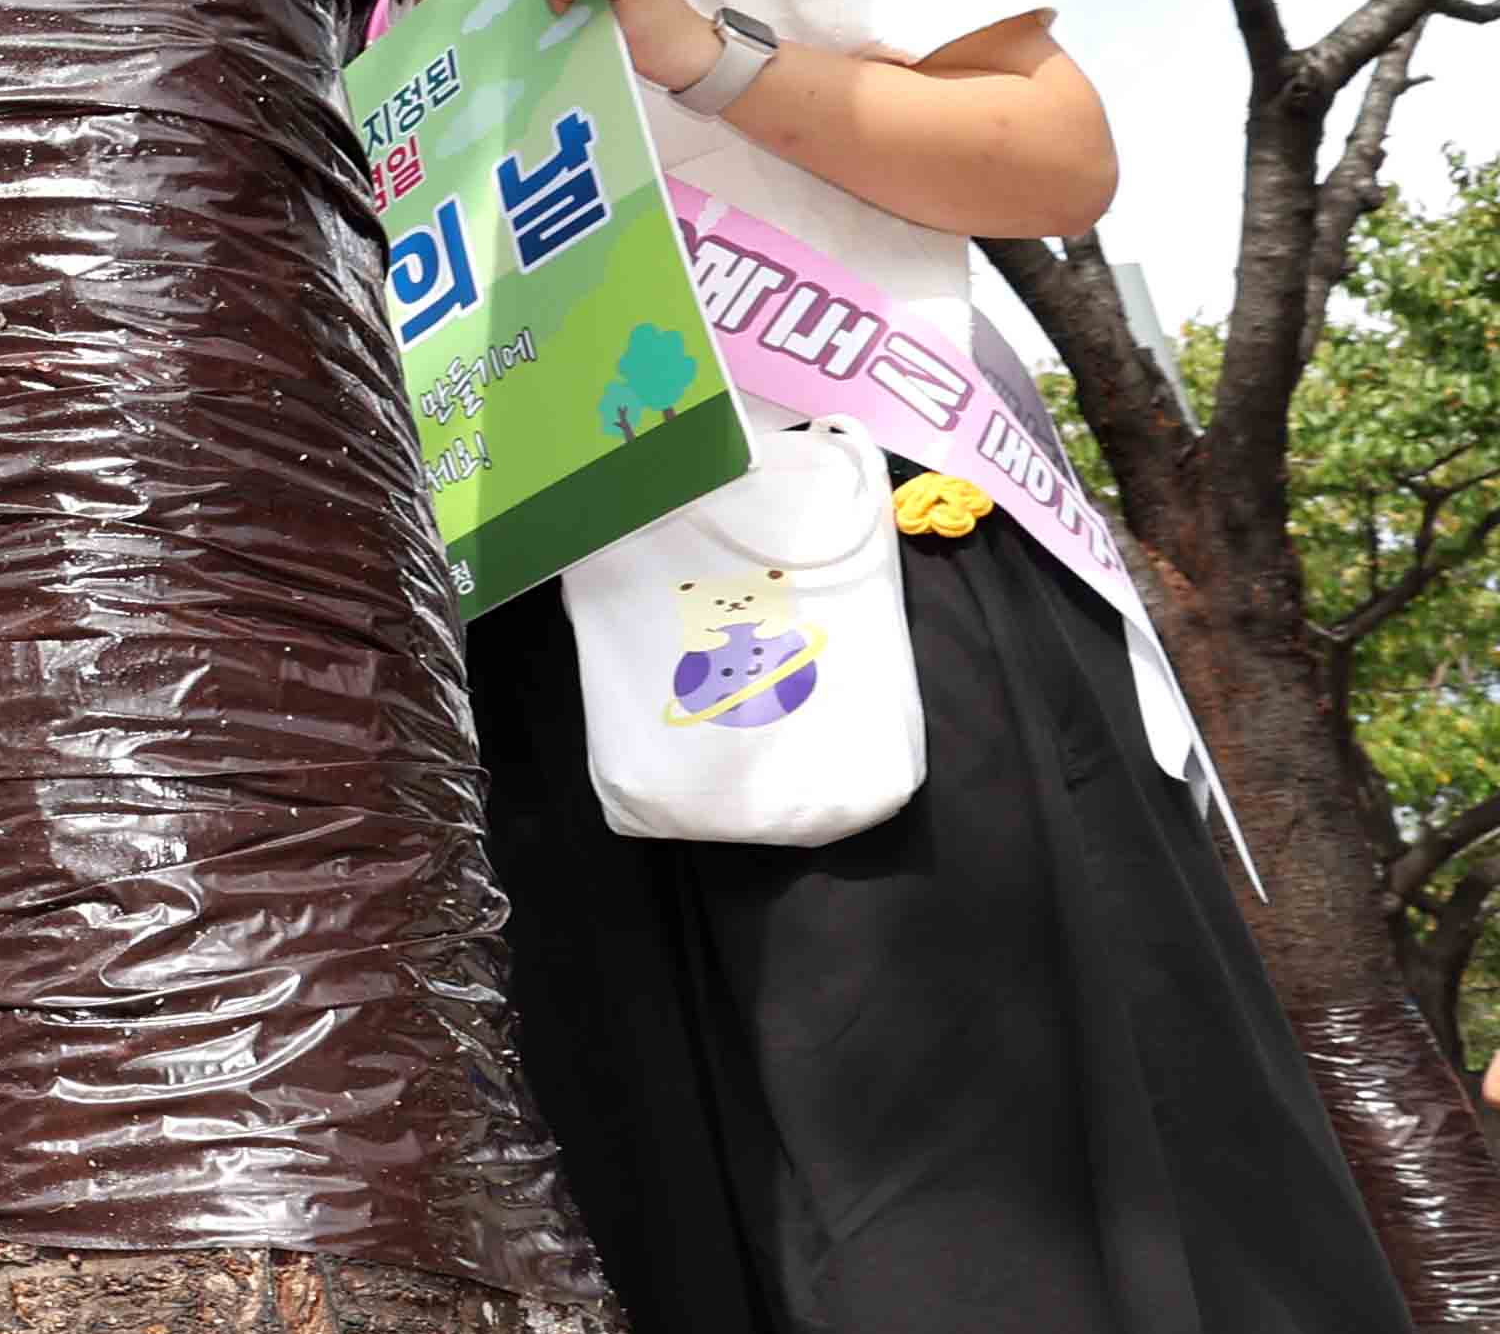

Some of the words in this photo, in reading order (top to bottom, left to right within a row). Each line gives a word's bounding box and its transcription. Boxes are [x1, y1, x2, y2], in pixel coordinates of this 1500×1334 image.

[363, 48, 462, 158] 지정된
[497, 107, 613, 273] 날
[420, 327, 539, 427] 만들기에
